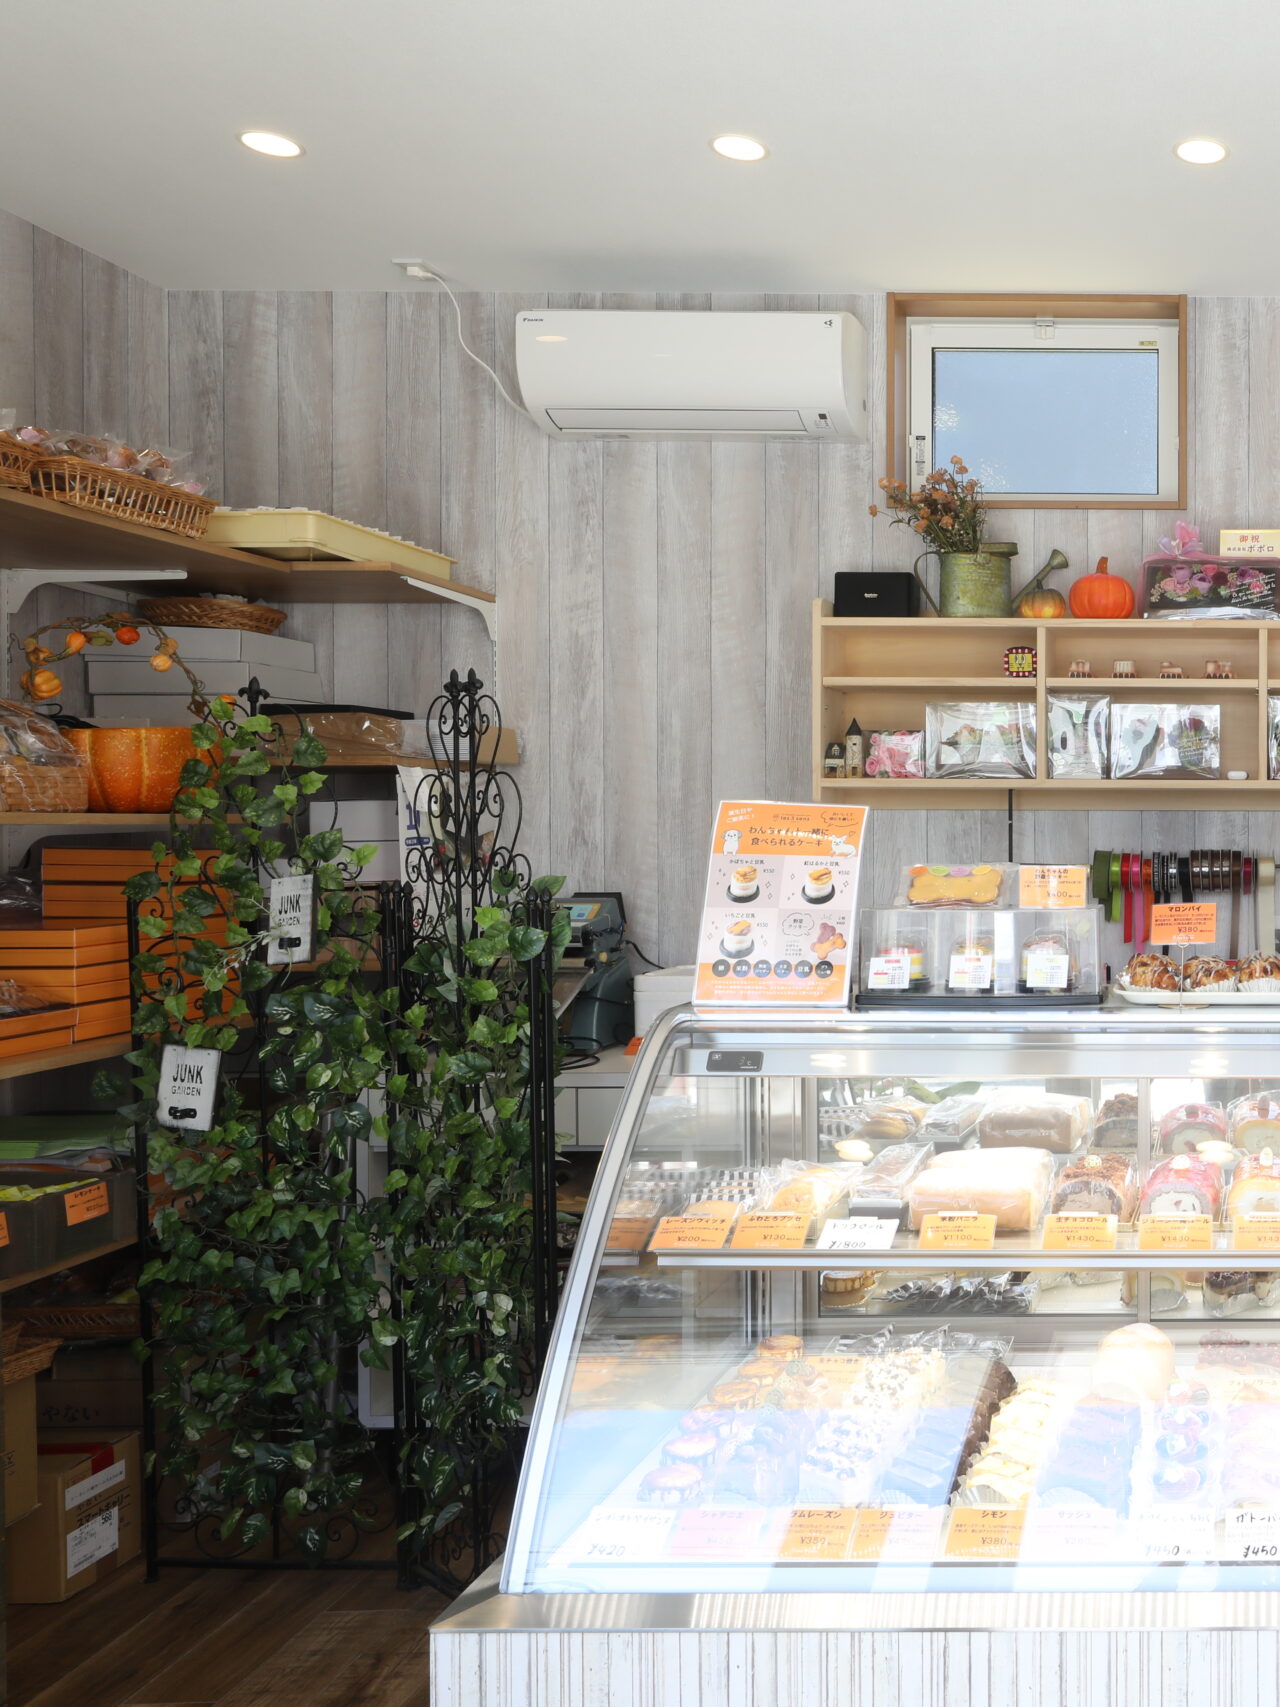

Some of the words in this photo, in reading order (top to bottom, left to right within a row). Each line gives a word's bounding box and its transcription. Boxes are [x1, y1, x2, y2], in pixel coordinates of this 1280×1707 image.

[751, 838, 823, 847] 食べられるケーキ
[279, 893, 301, 915] JUNK
[173, 1064, 203, 1084] JUNK
[980, 1509, 1009, 1519] シモン
[980, 1536, 1008, 1546] ¥380
[1242, 1545, 1278, 1559] ¥450
